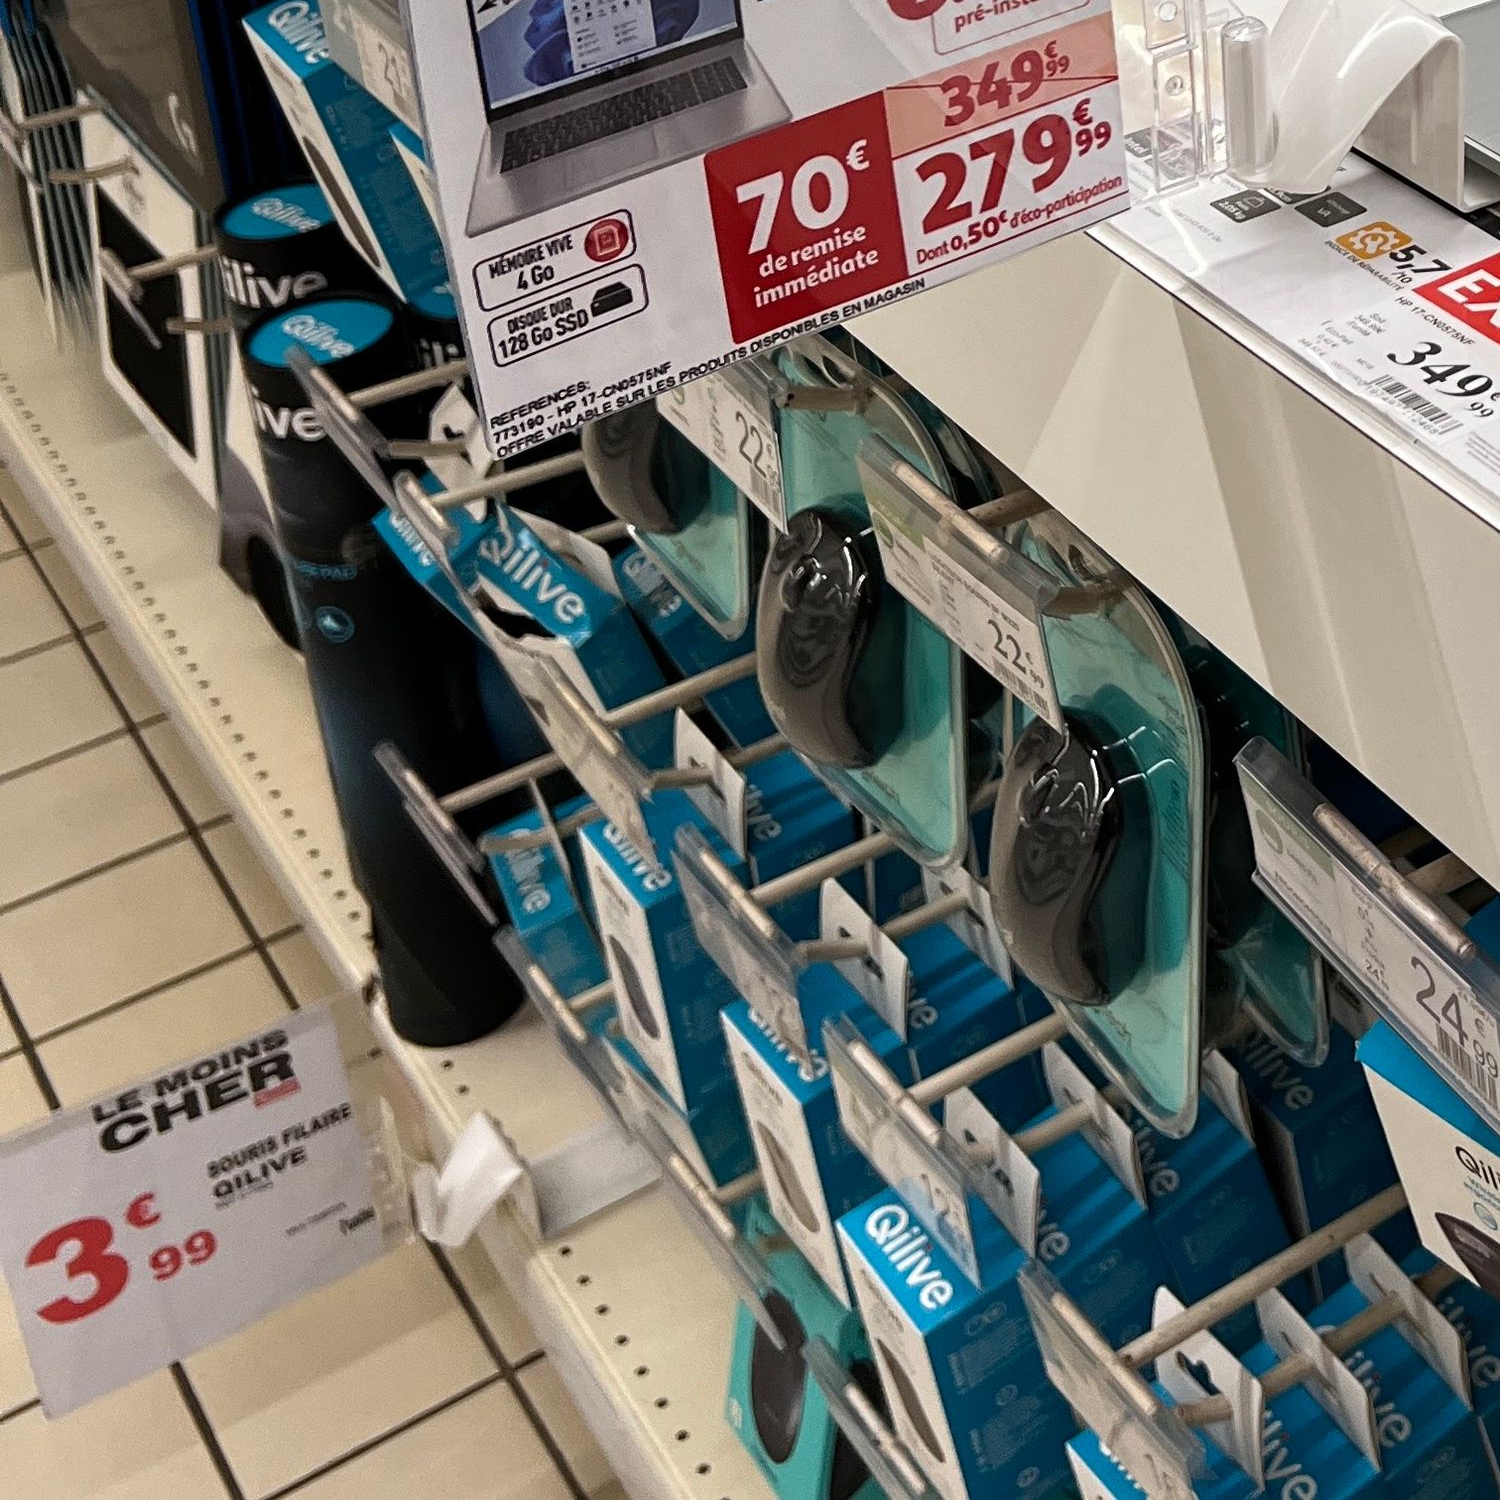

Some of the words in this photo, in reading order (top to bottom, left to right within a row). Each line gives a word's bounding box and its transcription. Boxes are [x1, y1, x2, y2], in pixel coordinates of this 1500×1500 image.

[489, 242, 545, 279] MÉMOIRE
[544, 234, 574, 257] VIVE
[517, 273, 529, 291] 4
[530, 264, 555, 286] Go
[753, 245, 879, 309] immédiate
[759, 250, 789, 278] de
[788, 222, 868, 268] remise
[1388, 243, 1454, 276] 5,7
[221, 254, 329, 309] ilive
[497, 335, 529, 360] 128
[530, 326, 554, 348] Go
[554, 308, 590, 337] SSD
[506, 305, 549, 335] DISQUE
[549, 296, 574, 319] DUR
[496, 429, 546, 460] OFFRE
[549, 401, 613, 438] VALABLE
[616, 388, 647, 409] SUR
[648, 375, 676, 401] LES
[679, 346, 748, 389] PRODUITS
[750, 310, 841, 354] DISPONIBLES
[842, 301, 862, 318] EN
[863, 278, 927, 310] MAGASIN
[489, 380, 592, 430] REFERENCES:
[478, 532, 586, 625] Qilive
[988, 619, 1027, 675] 22
[1409, 956, 1470, 1048] 24
[1472, 1038, 1500, 1079] 99
[91, 1087, 145, 1125] LE
[153, 1028, 290, 1098] MOINS
[99, 1049, 297, 1155] CHER
[206, 1134, 279, 1180] SOURIS
[281, 1101, 353, 1147] FILAIRE
[212, 1145, 308, 1200] QILIVE
[24, 1215, 129, 1326] 3
[124, 1190, 163, 1232] €
[147, 1227, 219, 1283] 99
[865, 1204, 954, 1313] Qilive
